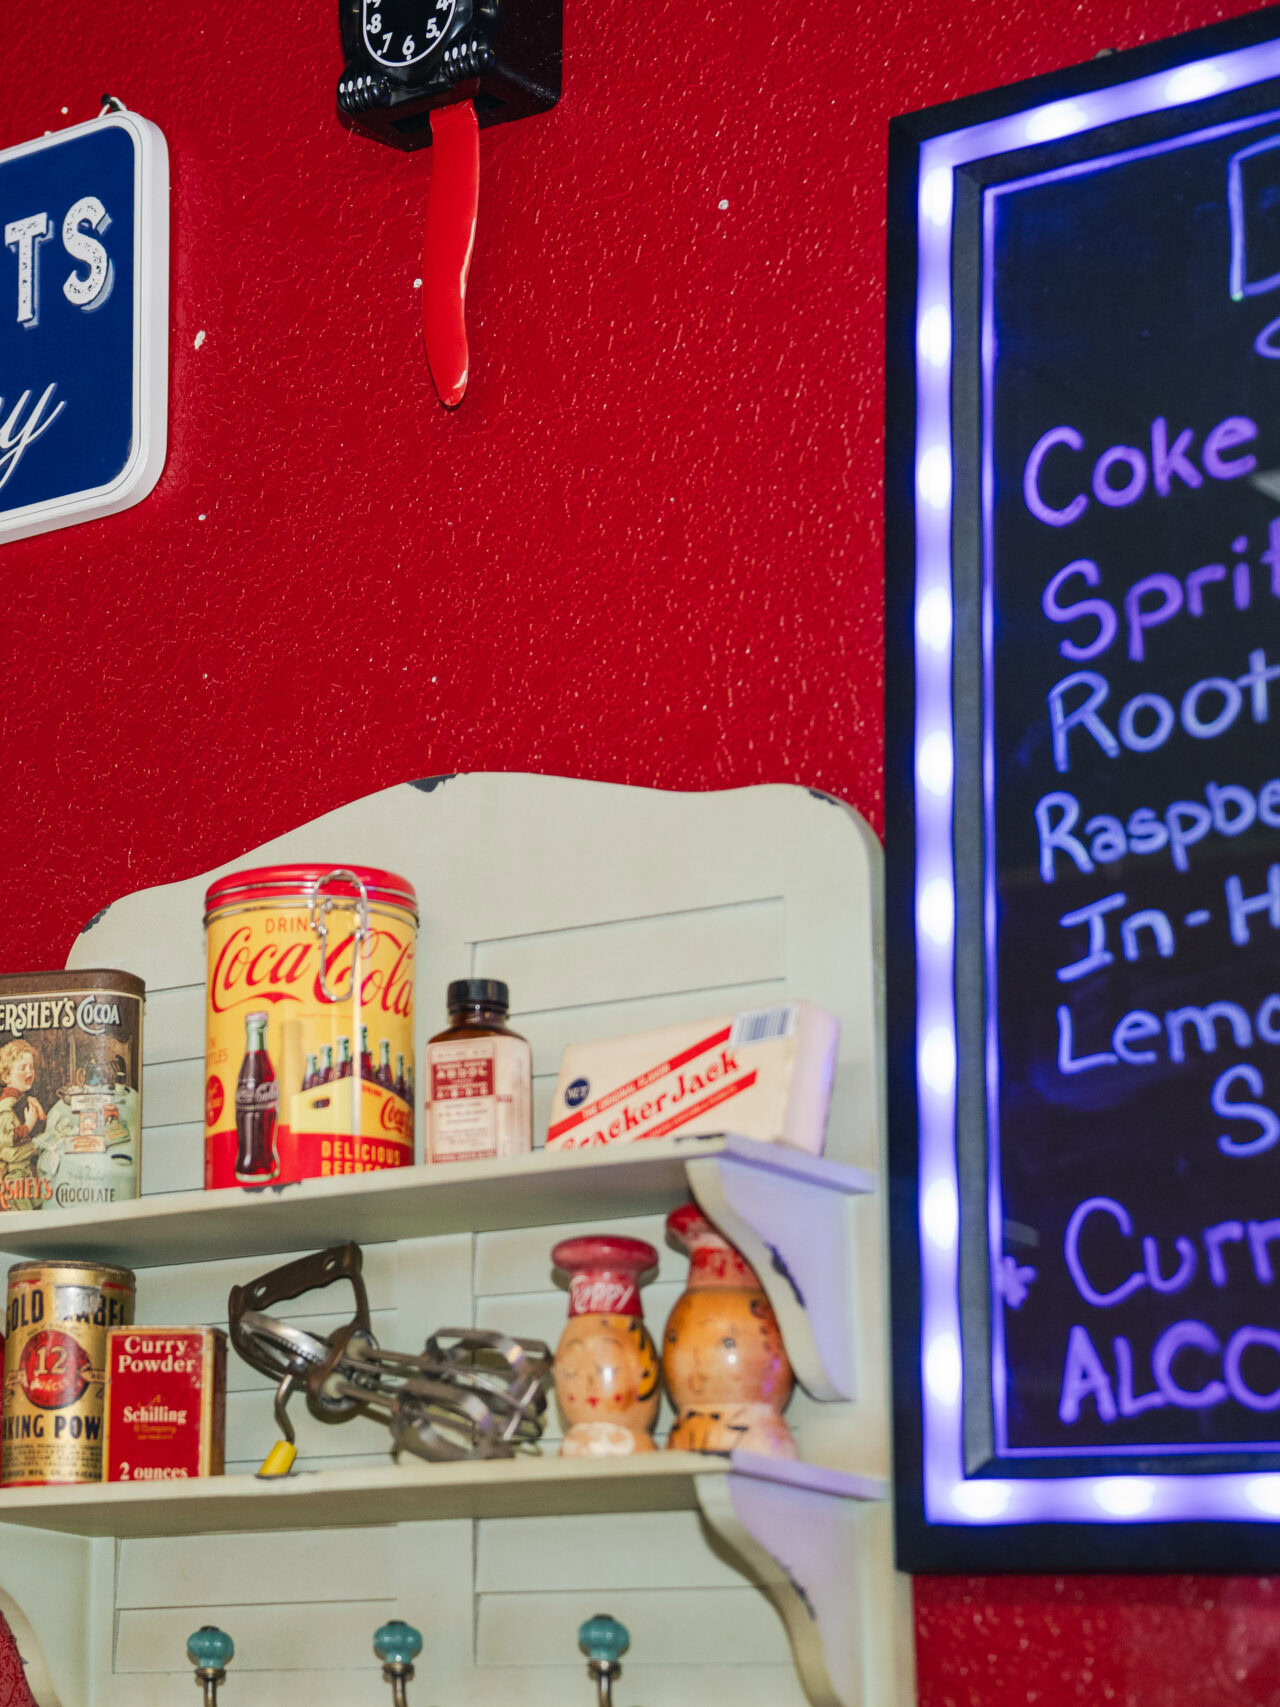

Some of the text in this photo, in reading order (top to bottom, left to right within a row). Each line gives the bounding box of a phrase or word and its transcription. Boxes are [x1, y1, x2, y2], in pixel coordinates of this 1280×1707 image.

[371, 13, 382, 34] 8
[425, 17, 438, 39] 5
[382, 32, 394, 54] 7
[402, 34, 415, 56] 6
[1022, 415, 1258, 527] Coke
[1047, 647, 1280, 773] Root
[77, 994, 121, 1035] COCOA
[671, 1050, 740, 1103] Jack
[321, 1140, 401, 1166] DELICIOUS
[55, 1181, 116, 1208] CHOCOLATE
[124, 1335, 188, 1357] Curry
[36, 1345, 68, 1376] 12
[118, 1354, 196, 1373] Powder
[123, 1405, 188, 1426] Schilling
[120, 1461, 189, 1481] 2 ounces
